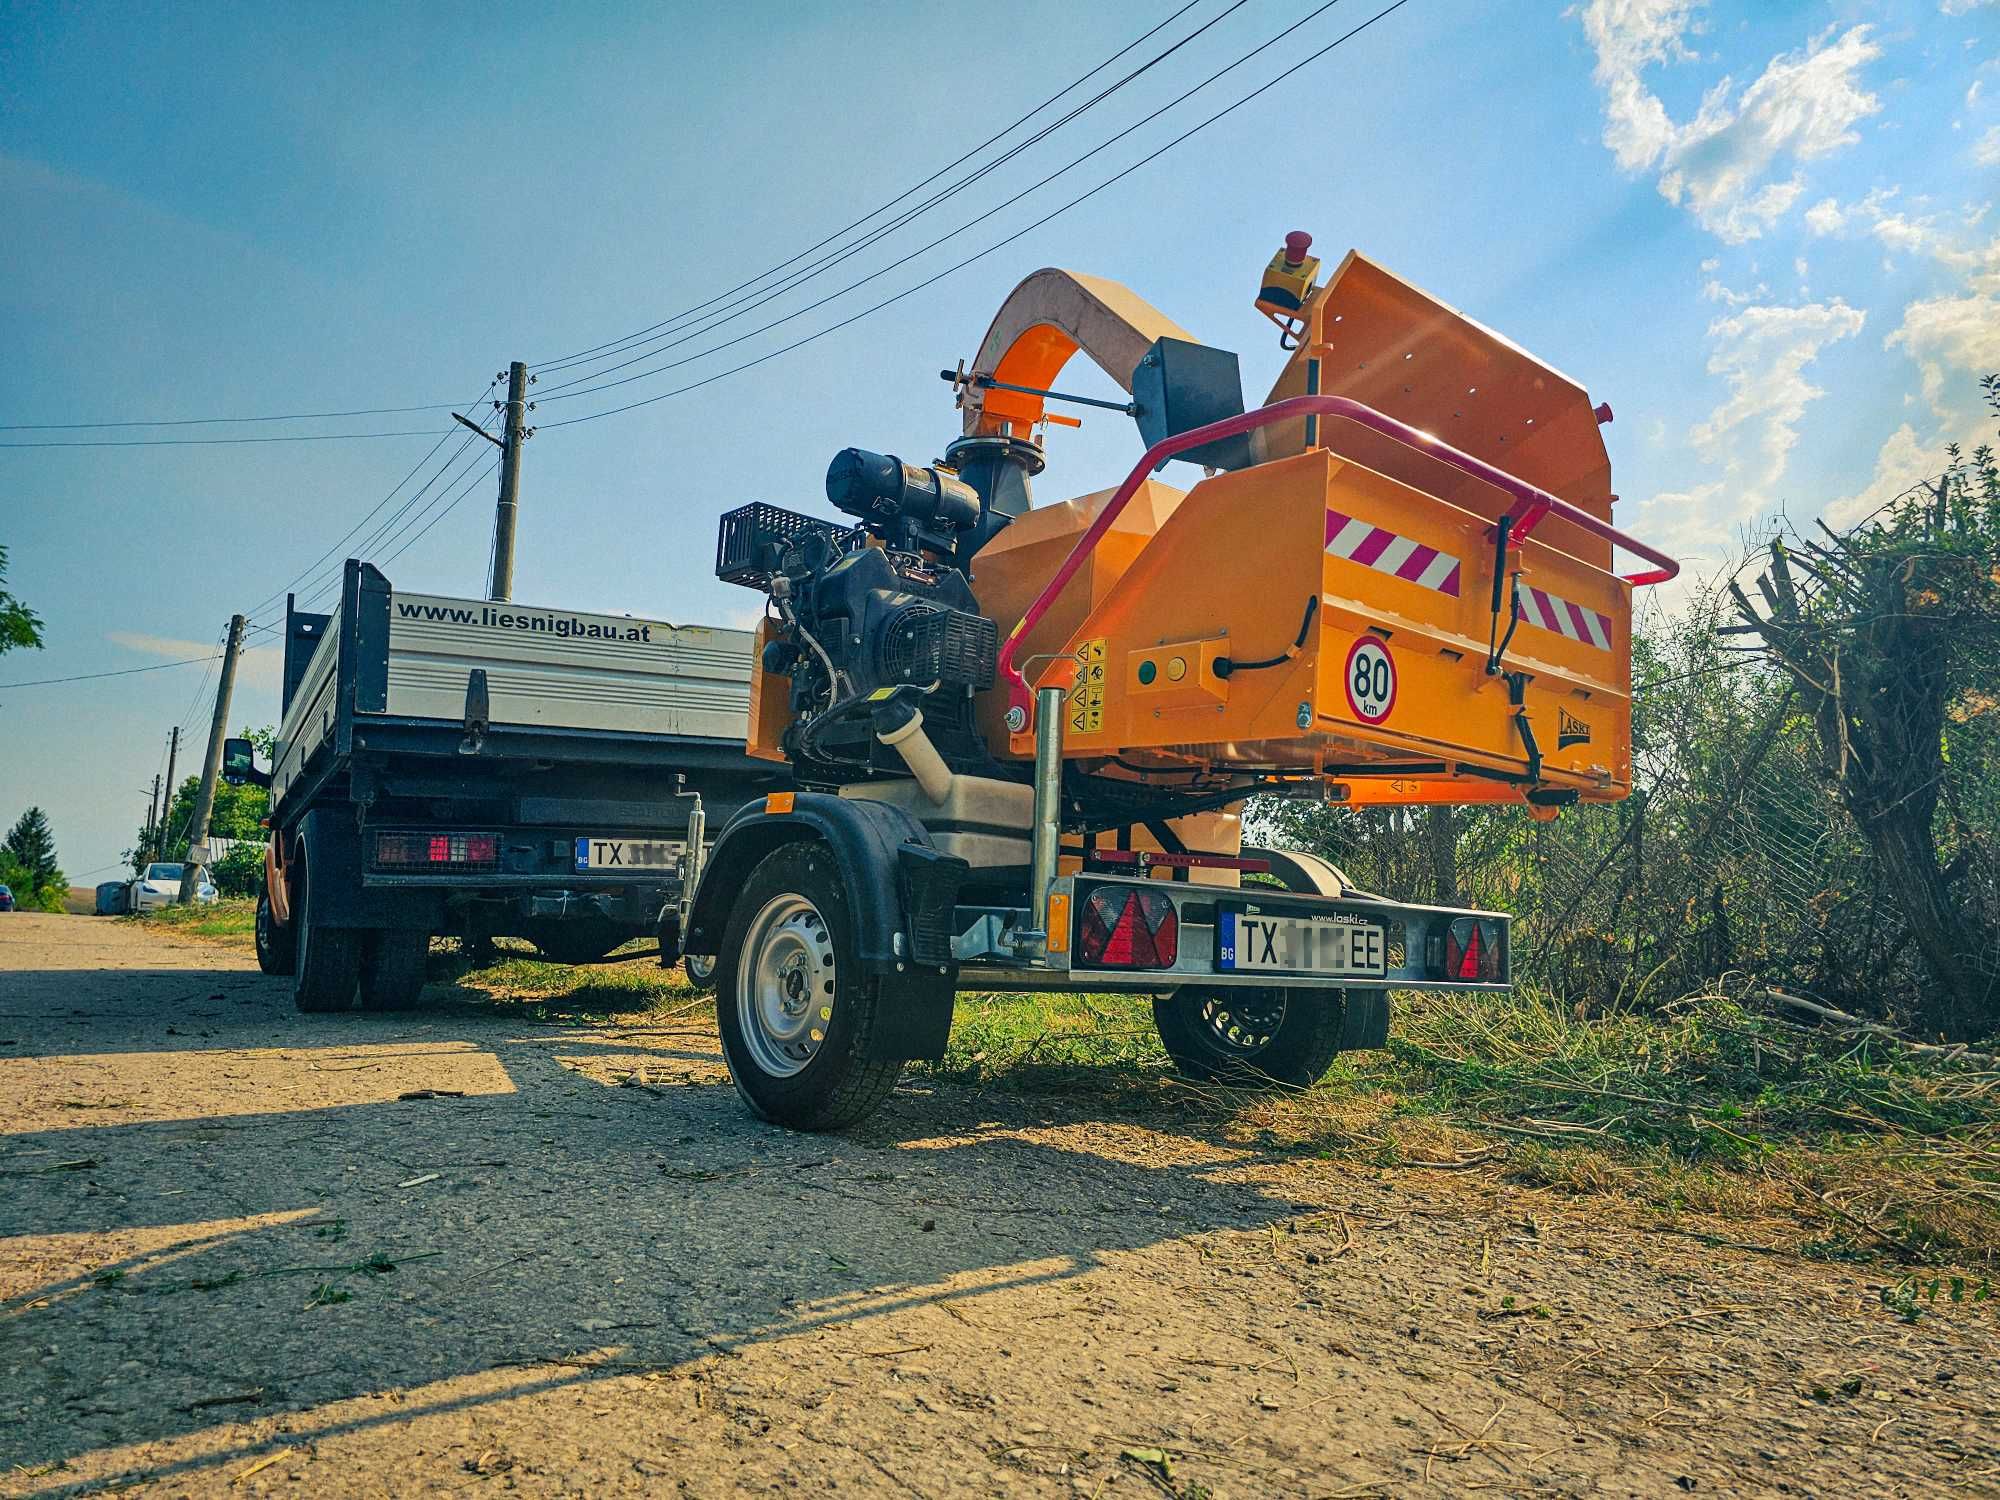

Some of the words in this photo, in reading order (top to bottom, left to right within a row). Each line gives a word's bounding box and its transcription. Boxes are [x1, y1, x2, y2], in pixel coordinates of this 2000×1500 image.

[397, 602, 651, 643] www.liesnigbau.at
[1354, 653, 1389, 701] 80
[1363, 700, 1378, 717] km
[1559, 710, 1590, 735] LASKI
[593, 842, 623, 865] TX
[1221, 947, 1234, 961] BG
[1241, 920, 1278, 964] TX
[1351, 929, 1380, 969] EE
